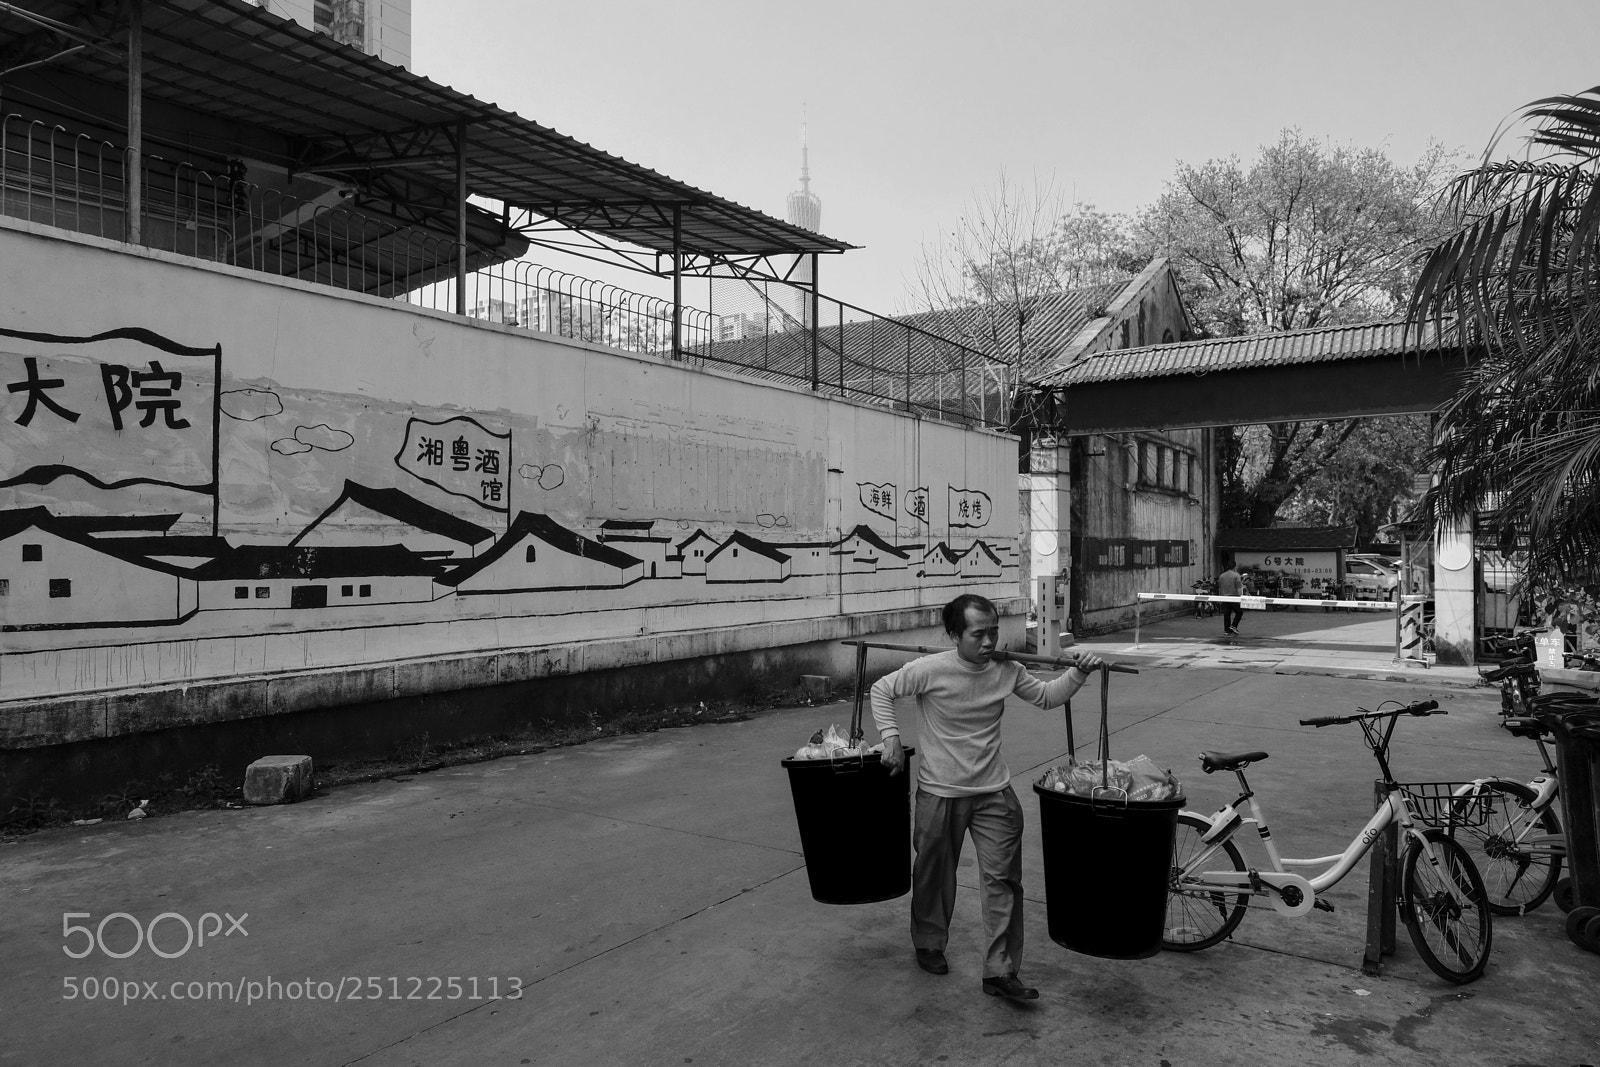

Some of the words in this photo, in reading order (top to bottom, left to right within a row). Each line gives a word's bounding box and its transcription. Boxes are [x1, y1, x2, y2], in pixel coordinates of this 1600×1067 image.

[7, 357, 191, 430] 大院
[417, 435, 499, 474] 湘粤酒
[481, 478, 503, 501] 馆
[870, 488, 892, 510] 海鲜
[914, 495, 926, 516] 酒
[958, 498, 981, 519] 烧烤
[1264, 555, 1304, 567] 6号大院
[1362, 828, 1378, 845] ofo
